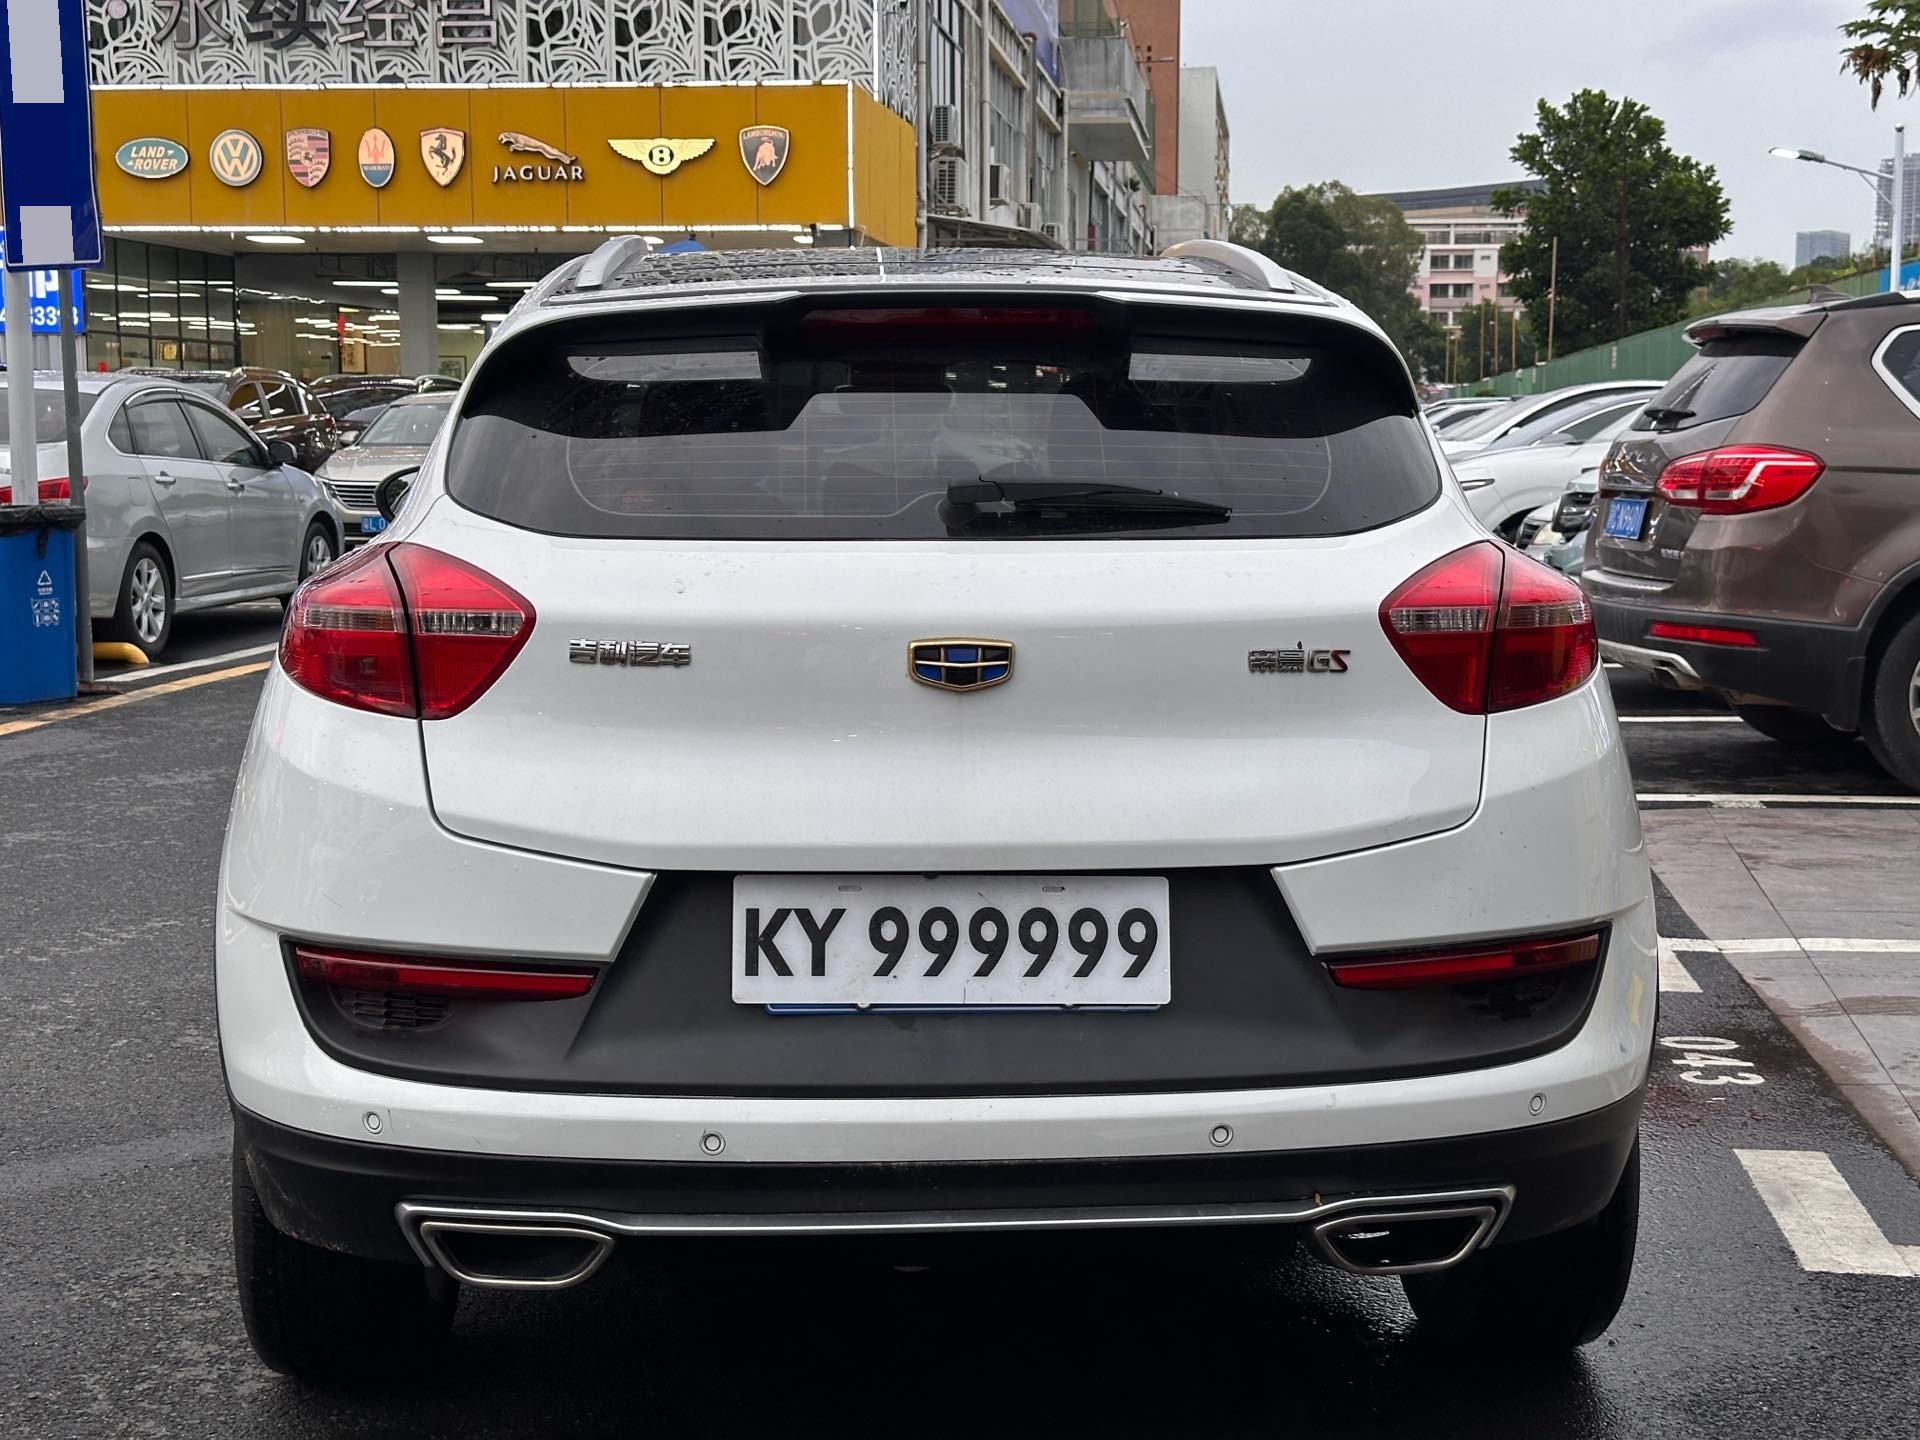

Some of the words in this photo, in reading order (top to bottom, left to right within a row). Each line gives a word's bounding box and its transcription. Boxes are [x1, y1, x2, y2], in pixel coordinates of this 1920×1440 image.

[131, 146, 165, 158] LAND
[134, 158, 178, 171] ROVER
[492, 165, 585, 183] JAGUAR
[569, 638, 690, 667] 吉利汽车
[744, 907, 847, 977] KY
[868, 906, 1159, 978] 999999
[1660, 1036, 1766, 1085] 043
